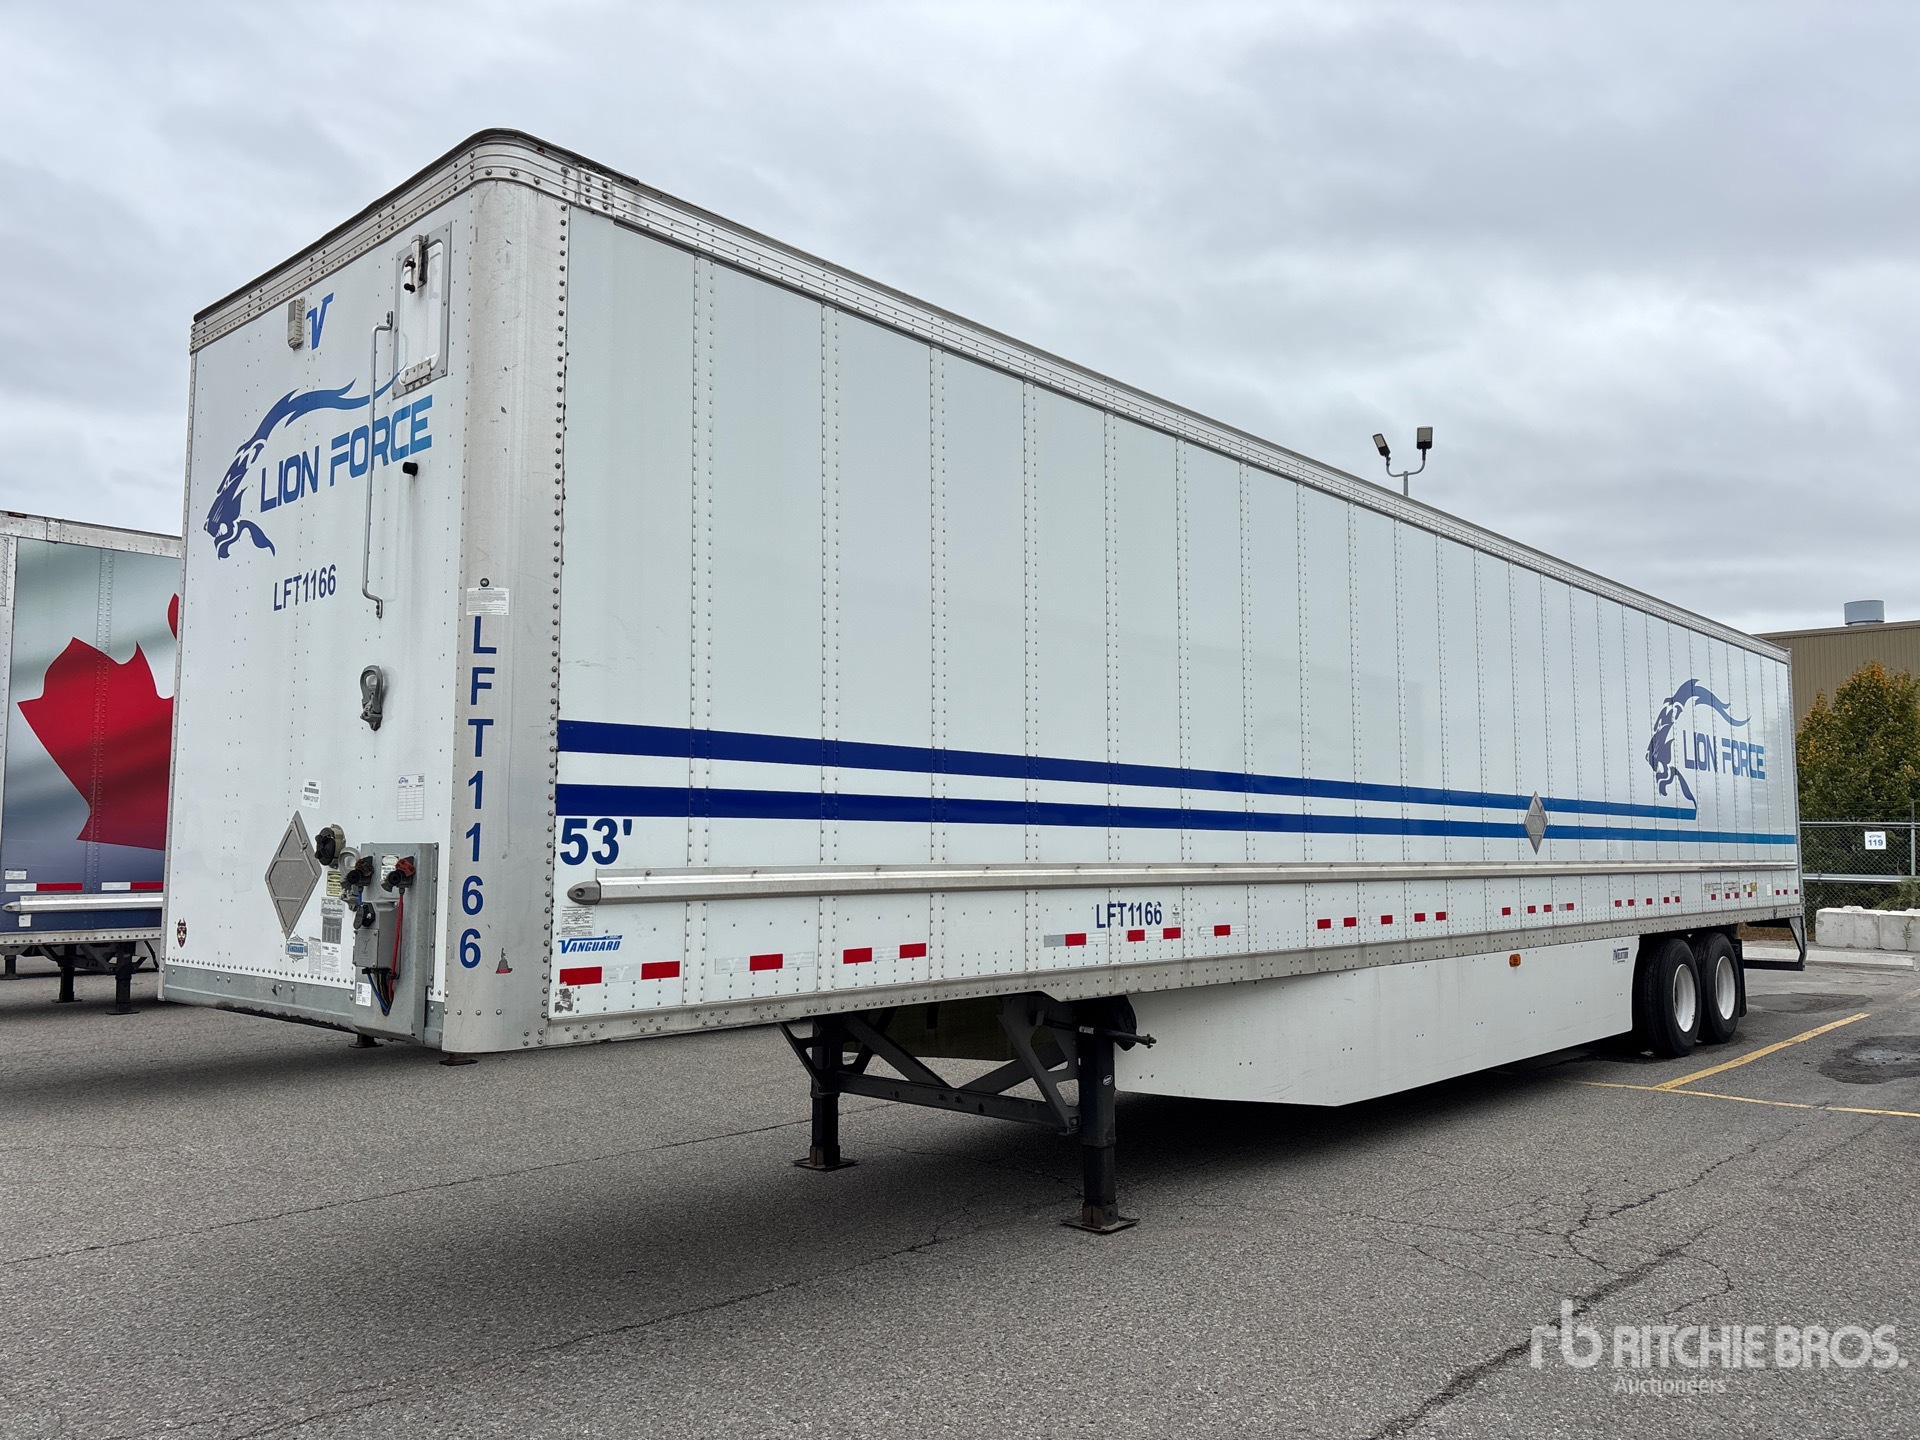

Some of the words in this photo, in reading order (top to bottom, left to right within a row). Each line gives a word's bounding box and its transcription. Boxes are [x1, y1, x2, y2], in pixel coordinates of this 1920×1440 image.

[260, 446, 319, 513] LION
[329, 395, 433, 487] FORCE
[273, 564, 337, 612] LFT1166
[1684, 731, 1717, 773] LION
[1722, 739, 1765, 779] FORCE
[459, 616, 497, 969] LFT1166
[559, 818, 633, 865] 53'
[1096, 901, 1162, 928] LFT1166
[558, 937, 621, 954] VANGUARD
